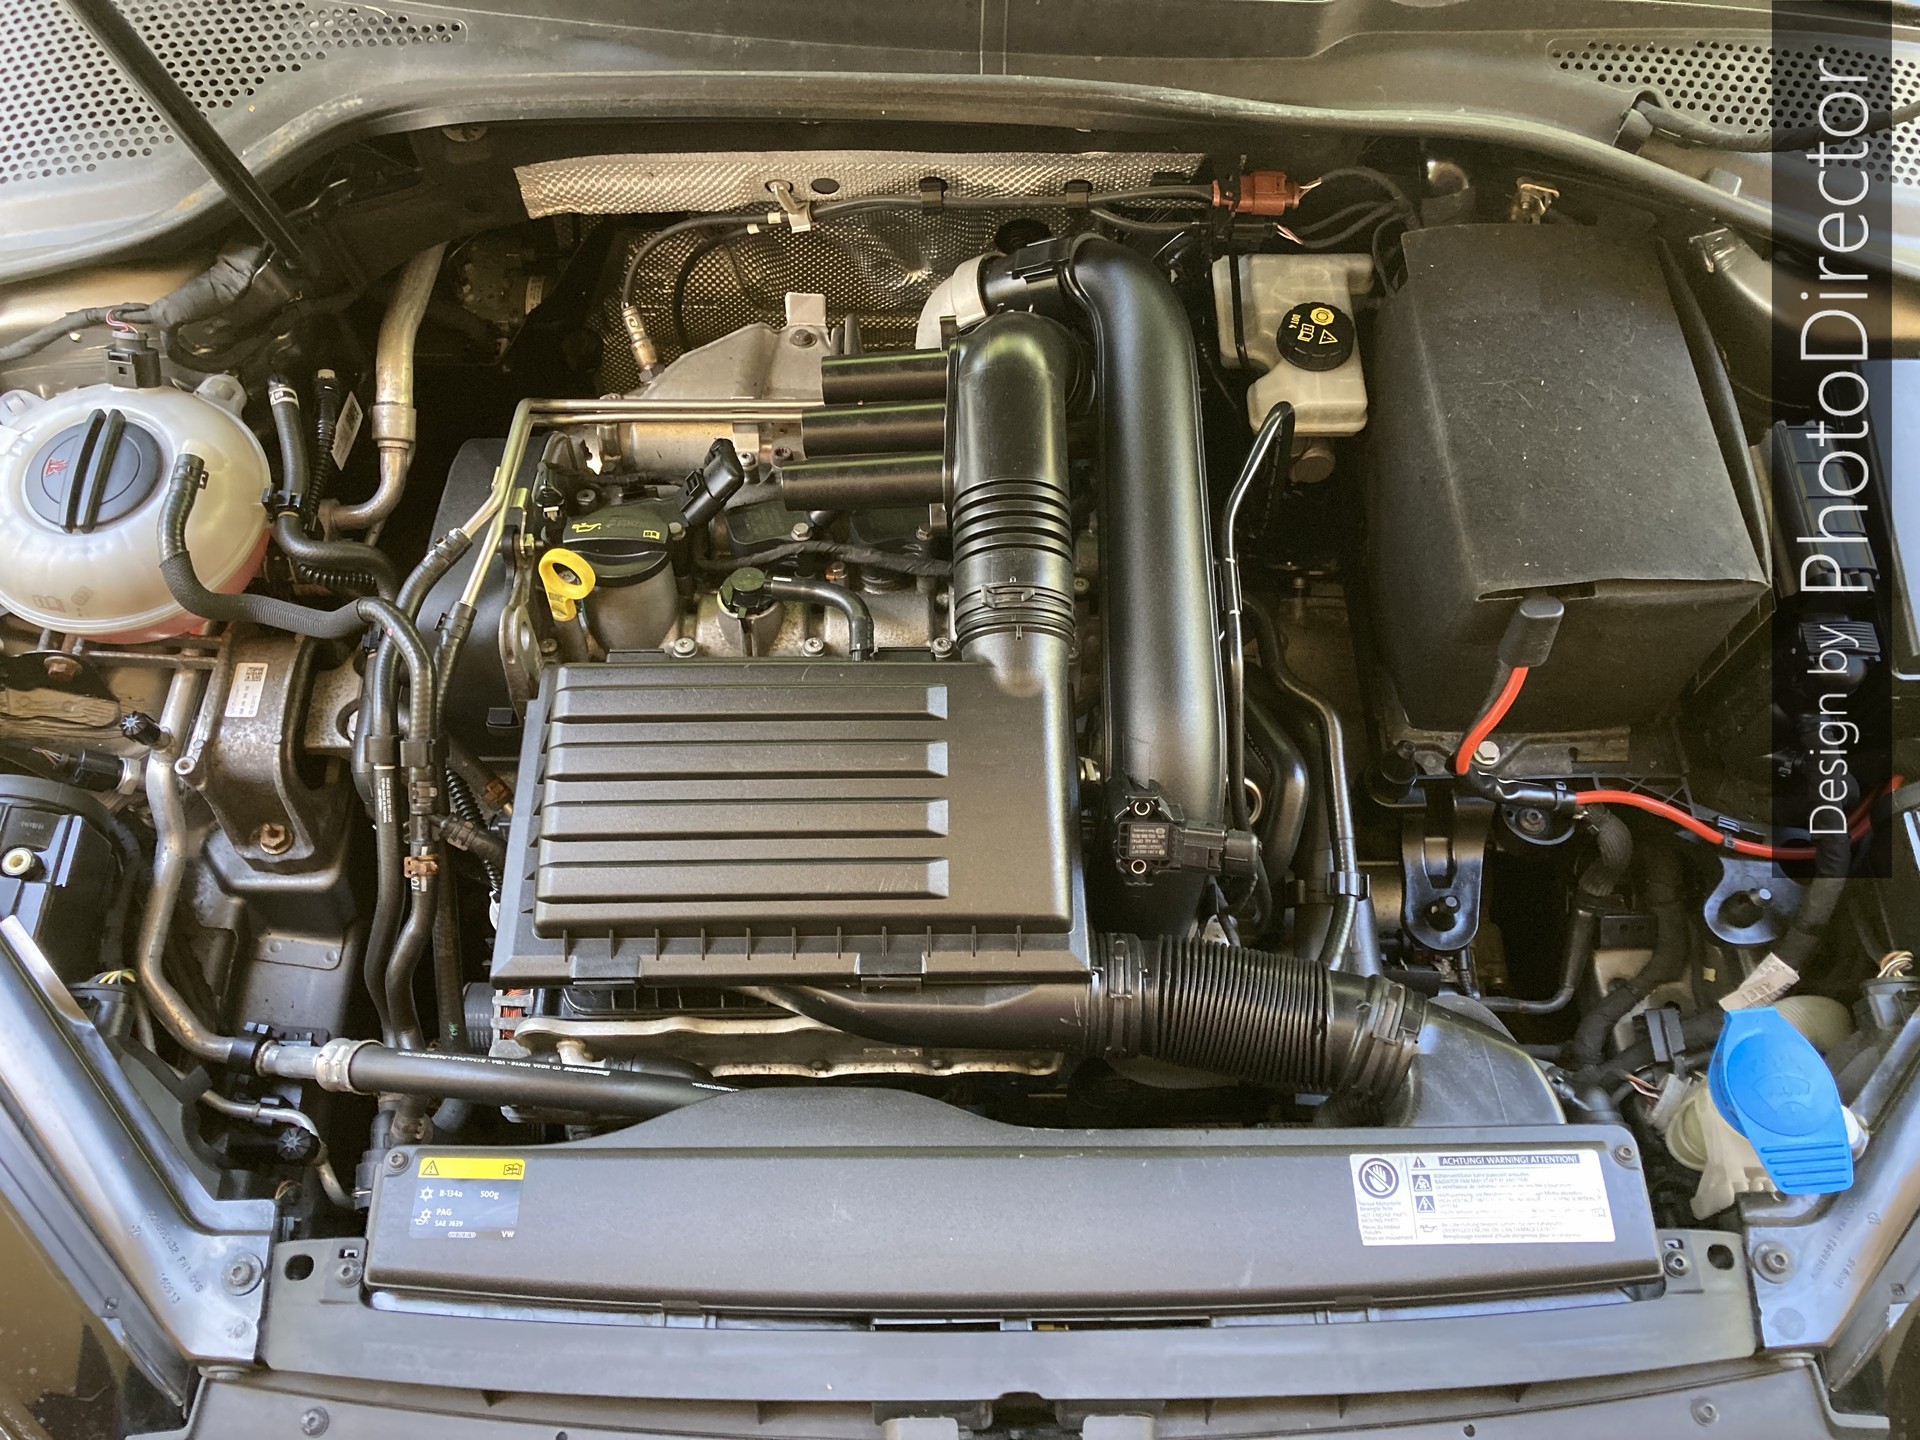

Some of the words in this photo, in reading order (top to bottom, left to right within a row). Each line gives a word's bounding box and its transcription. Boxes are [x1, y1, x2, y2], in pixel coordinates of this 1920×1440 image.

[1442, 1156, 1485, 1166] ACHTUNG!
[1486, 1155, 1529, 1165] WARNING!
[1530, 1153, 1578, 1163] ATTENTION!
[439, 1190, 463, 1198] R-134a
[480, 1190, 500, 1200] 500g
[436, 1208, 452, 1216] PAG
[501, 1230, 515, 1238] VW
